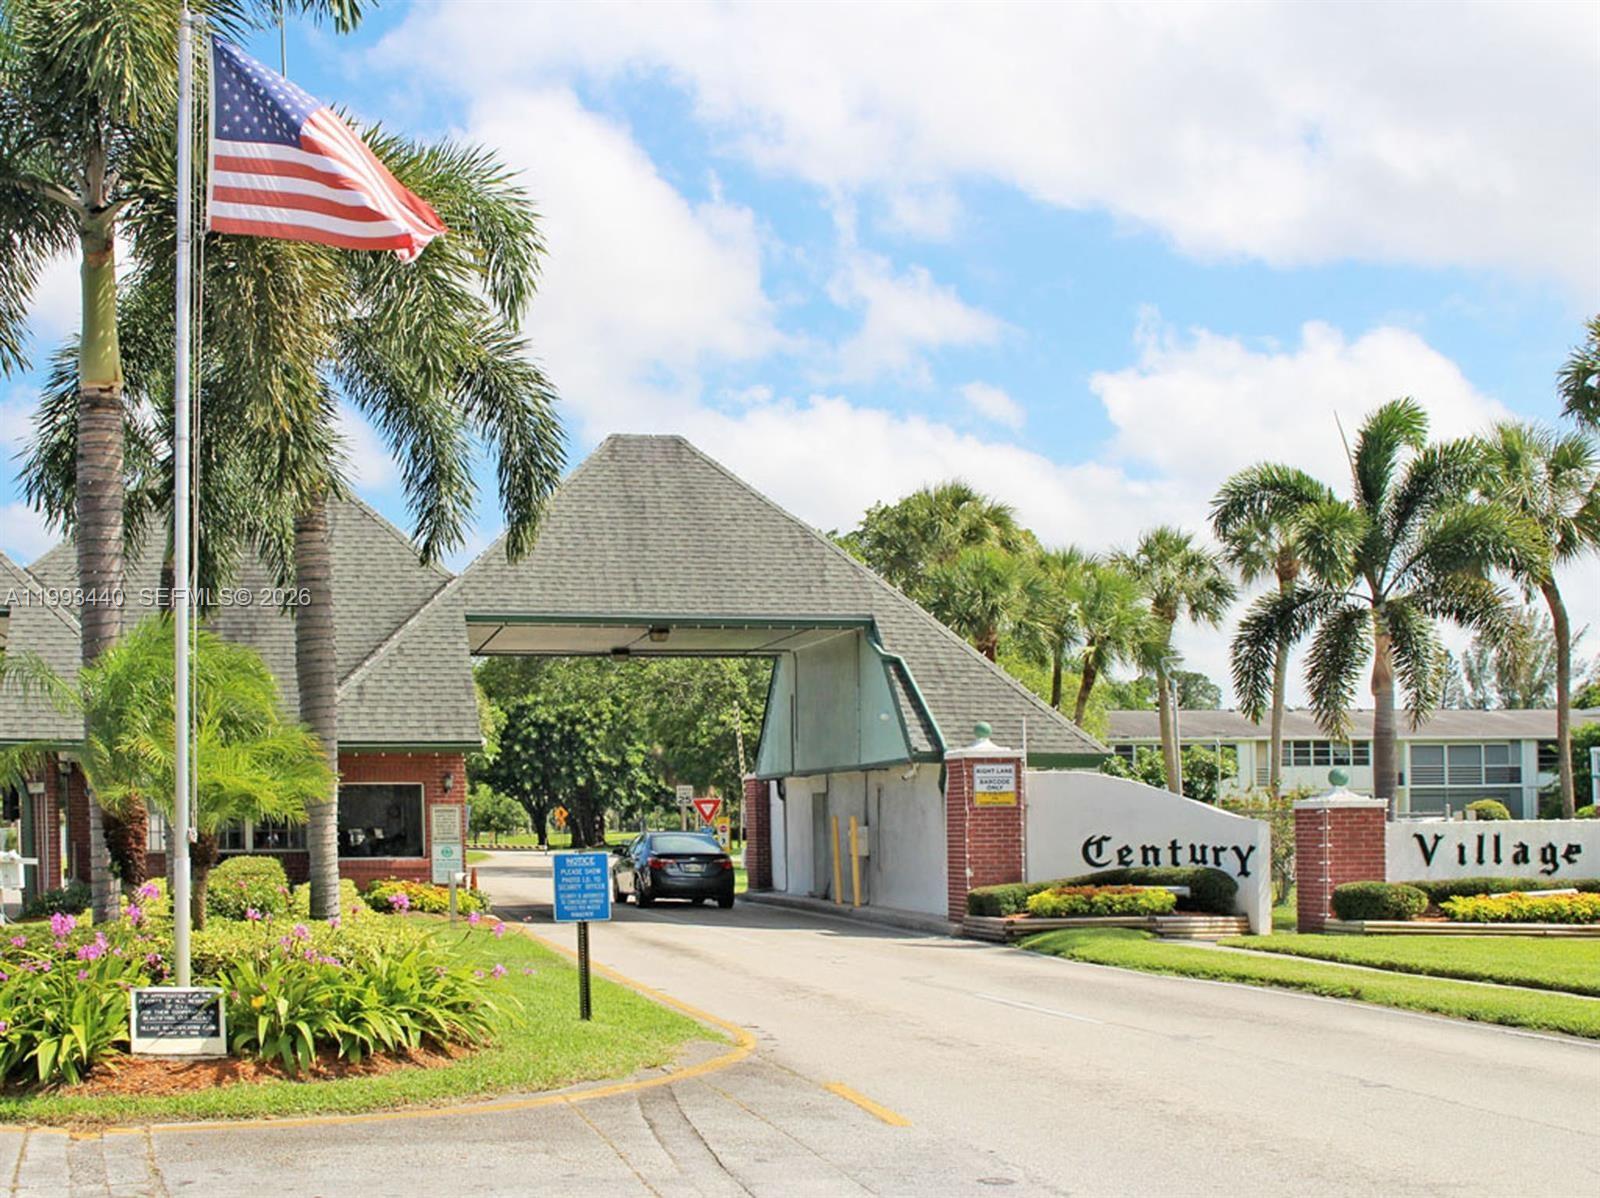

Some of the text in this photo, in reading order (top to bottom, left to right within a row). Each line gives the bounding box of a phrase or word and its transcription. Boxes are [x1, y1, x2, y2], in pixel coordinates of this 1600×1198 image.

[565, 857, 595, 867] NOTICE
[1081, 834, 1256, 878] Century
[1412, 831, 1583, 876] Village
[560, 868, 583, 876] PLEASE
